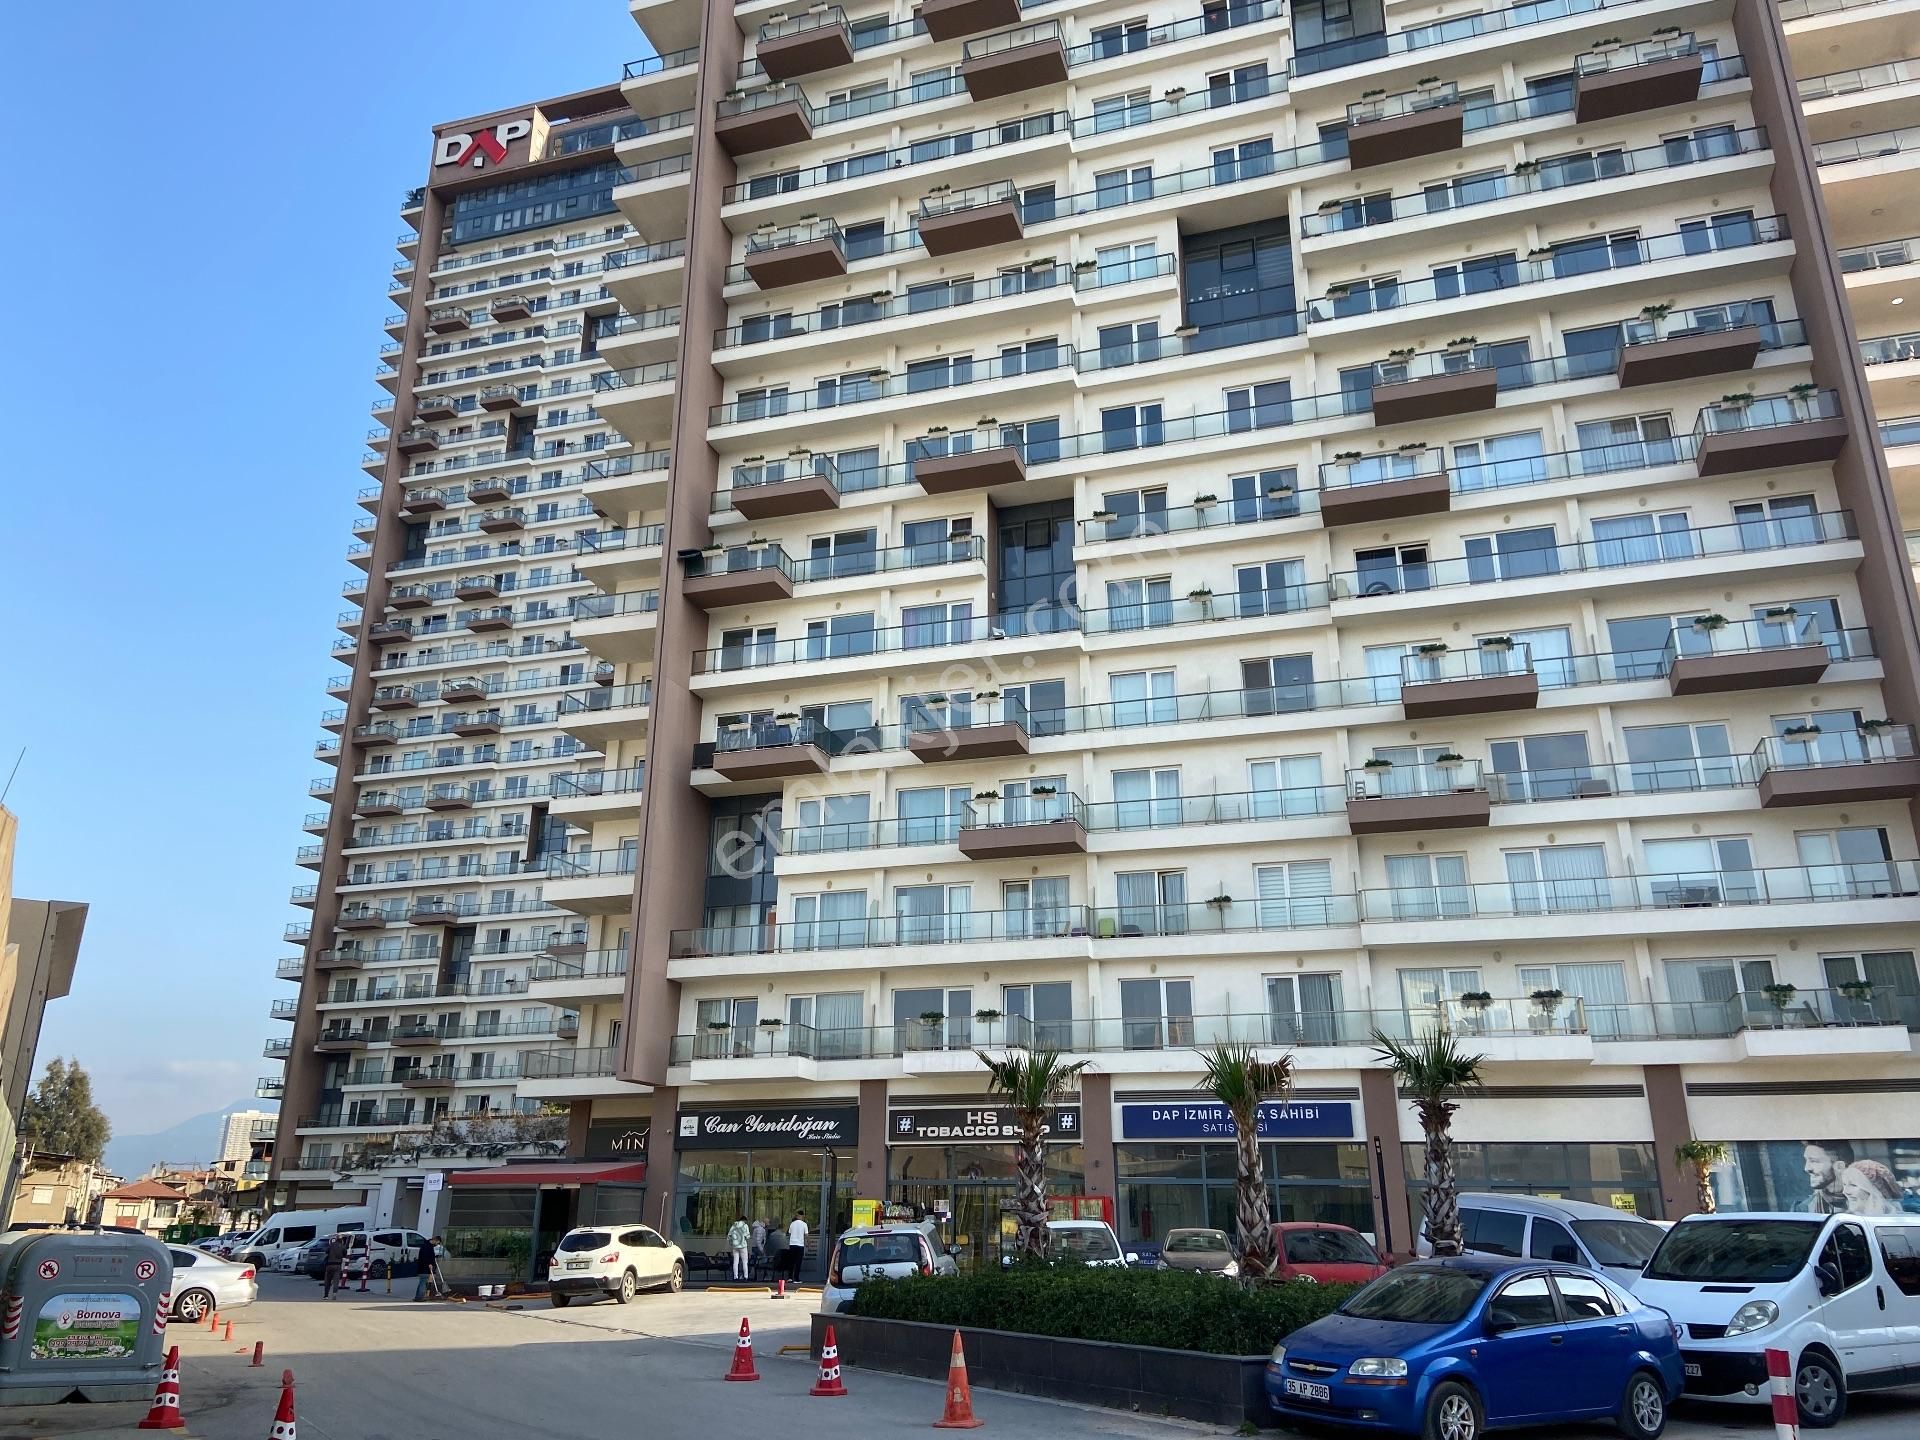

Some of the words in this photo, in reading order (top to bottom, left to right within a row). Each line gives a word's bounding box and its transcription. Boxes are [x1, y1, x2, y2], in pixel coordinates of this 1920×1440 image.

[435, 119, 531, 168] DAP
[967, 1111, 998, 1125] HS
[1152, 1110, 1180, 1121] DAP
[1184, 1107, 1222, 1120] İZMİR
[1226, 1109, 1266, 1120] AA
[1269, 1106, 1320, 1120] SAHİBİ
[704, 1115, 743, 1133] Can
[744, 1114, 840, 1139] Yenidoğan
[916, 1125, 999, 1138] TOBACCO
[1002, 1124, 1051, 1136] SHP
[1202, 1123, 1235, 1134] SATIŞ
[76, 1309, 121, 1319] Bornova
[1287, 1380, 1296, 1392] 35
[1299, 1382, 1308, 1394] AP
